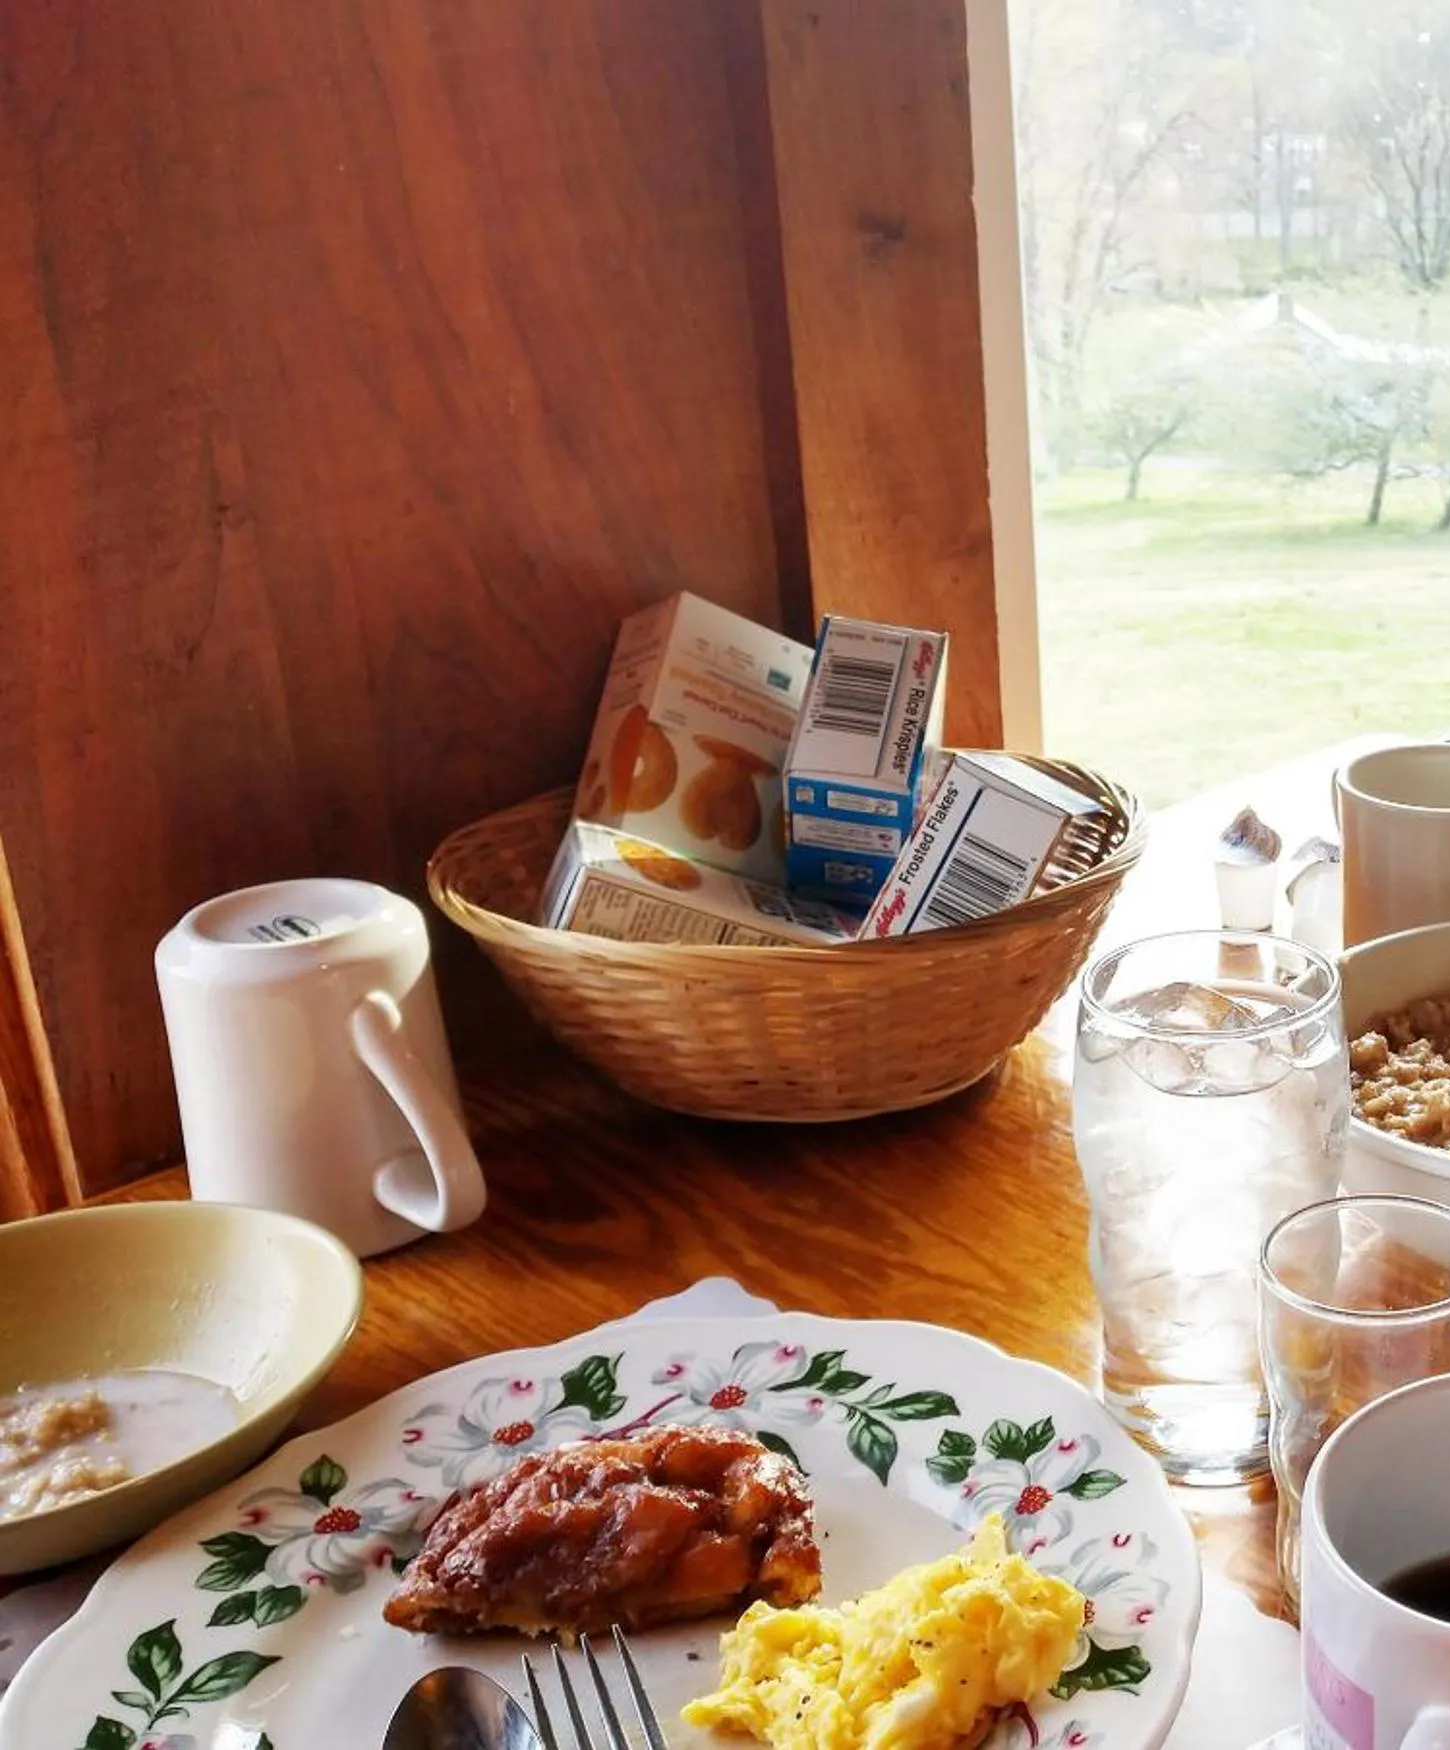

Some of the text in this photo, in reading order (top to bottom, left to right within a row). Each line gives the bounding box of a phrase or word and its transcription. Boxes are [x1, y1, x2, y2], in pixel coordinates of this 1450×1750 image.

[905, 687, 925, 716] Rice
[892, 717, 919, 771] Krispies
[899, 831, 935, 885] Frosted
[926, 785, 958, 833] Flakes
